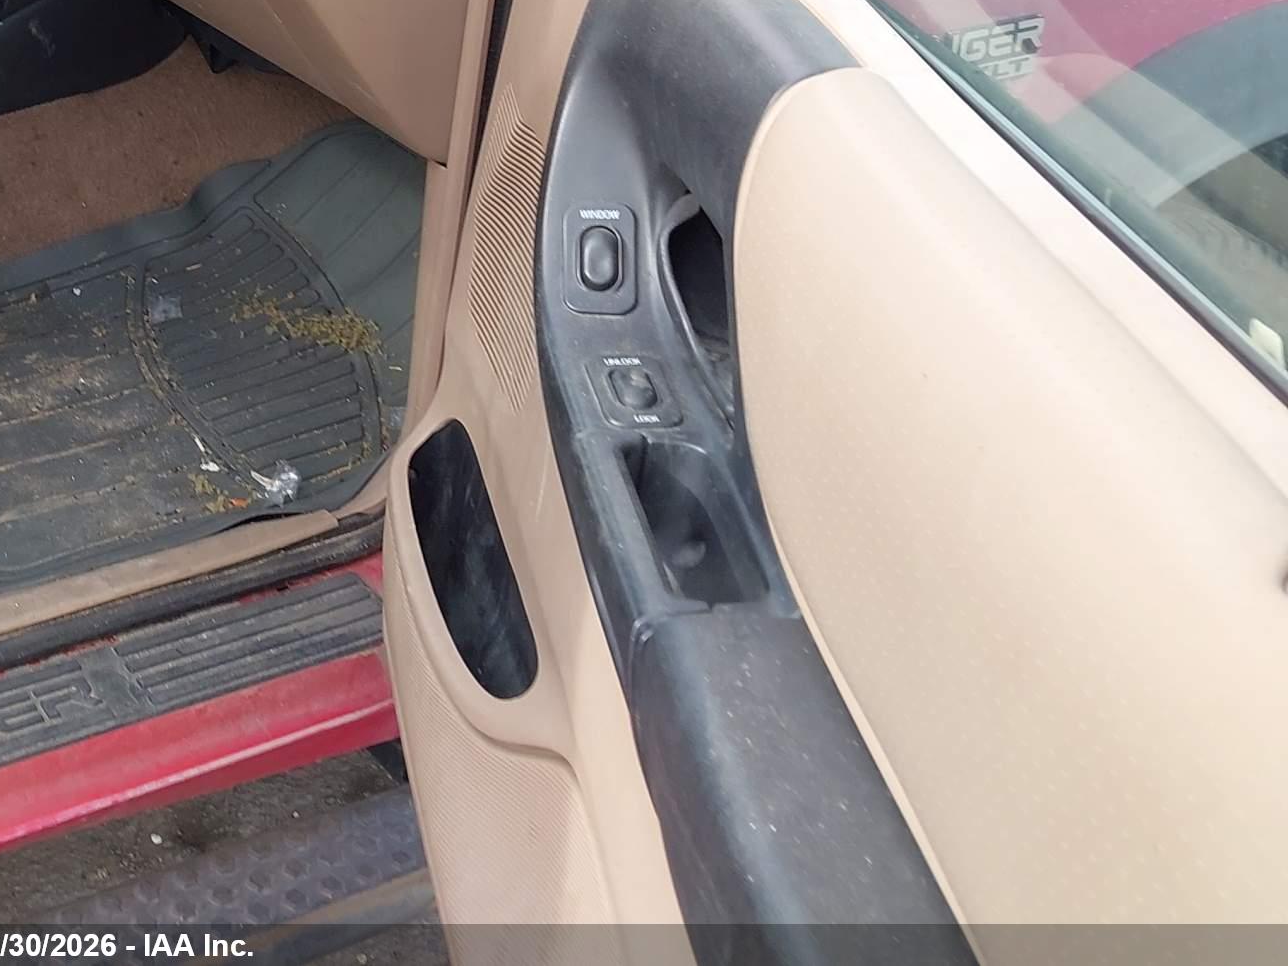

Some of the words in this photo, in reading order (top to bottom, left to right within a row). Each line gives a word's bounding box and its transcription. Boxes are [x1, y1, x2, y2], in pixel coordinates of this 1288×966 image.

[579, 209, 621, 220] WINDOW
[603, 357, 642, 367] UNLOCK
[633, 414, 660, 424] LOCK
